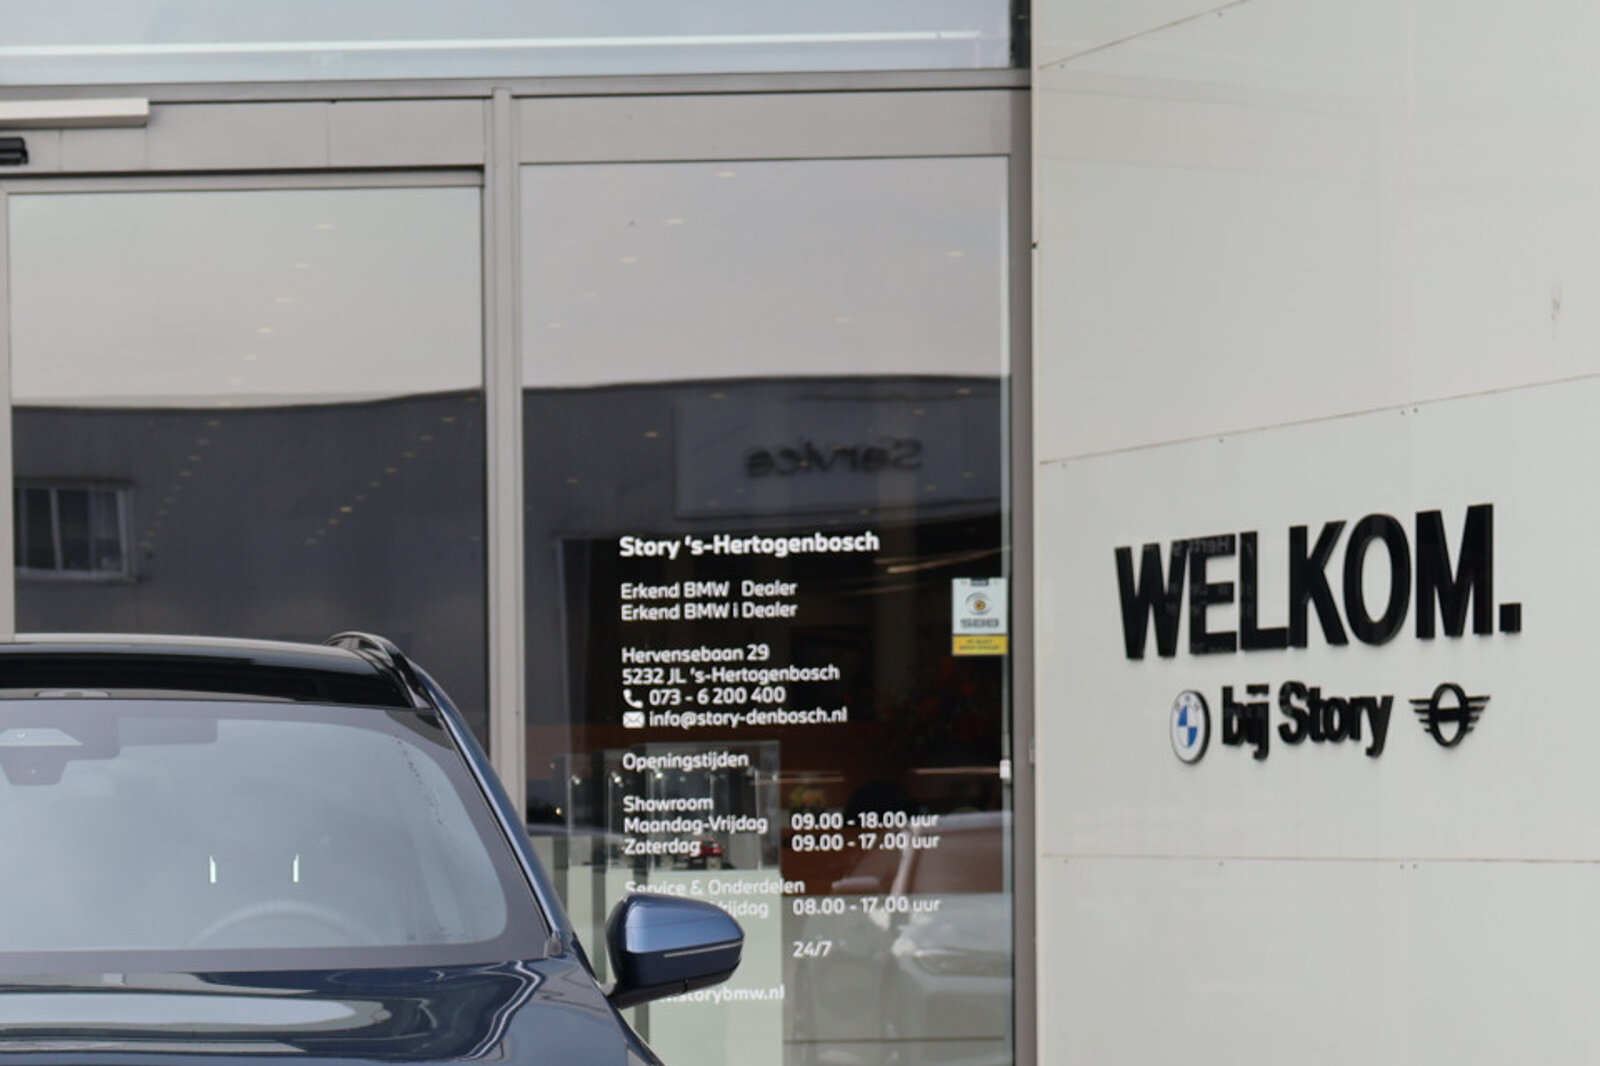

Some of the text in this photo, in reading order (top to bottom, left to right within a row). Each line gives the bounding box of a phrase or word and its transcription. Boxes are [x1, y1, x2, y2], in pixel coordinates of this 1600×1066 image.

[619, 531, 880, 559] Story 's-Hertogenbosch
[621, 579, 798, 600] Erkend BMW Dealer
[1114, 503, 1522, 660] WELKOM.
[621, 601, 798, 621] Erkend BMW i Dealer
[622, 644, 770, 664] Hervensebaan 29
[622, 664, 840, 688] 5232 JL 's-Hertogenbosch
[649, 689, 680, 706] 073
[697, 688, 709, 705] 6
[713, 687, 747, 704] 200
[751, 686, 786, 703] 400
[649, 706, 848, 729] info@story-denbosch.nl
[1221, 681, 1394, 760] bij Story
[622, 753, 749, 773] Openingstijden
[623, 795, 714, 812] Showroom
[623, 815, 769, 835] Maandag-Vrijdag
[791, 813, 843, 830] 09.00
[858, 812, 906, 829] 18.00
[910, 813, 940, 828] uur
[624, 839, 701, 857] Zaterdag
[791, 835, 844, 851] 09.00
[911, 835, 940, 849] uur
[690, 880, 701, 896] &
[707, 879, 806, 895] Onderdelen
[793, 898, 845, 915] 08.00
[912, 898, 940, 912] uur
[793, 941, 831, 958] 24/7
